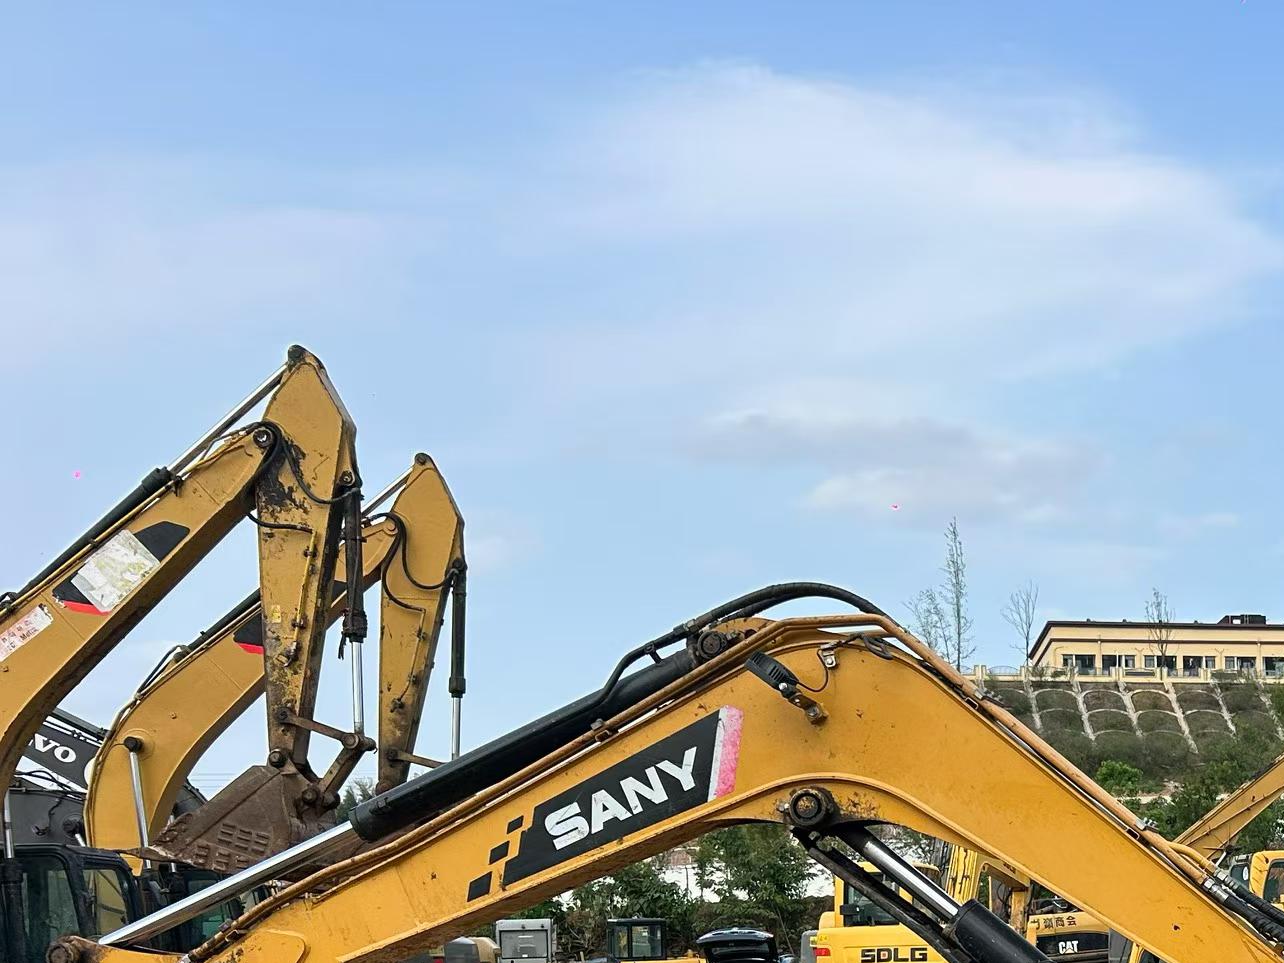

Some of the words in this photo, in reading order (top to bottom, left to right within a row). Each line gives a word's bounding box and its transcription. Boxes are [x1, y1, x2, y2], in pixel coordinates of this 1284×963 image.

[28, 732, 77, 763] VO
[544, 746, 697, 850] SANY
[860, 947, 928, 963] SDLG
[1058, 940, 1079, 955] CAT
